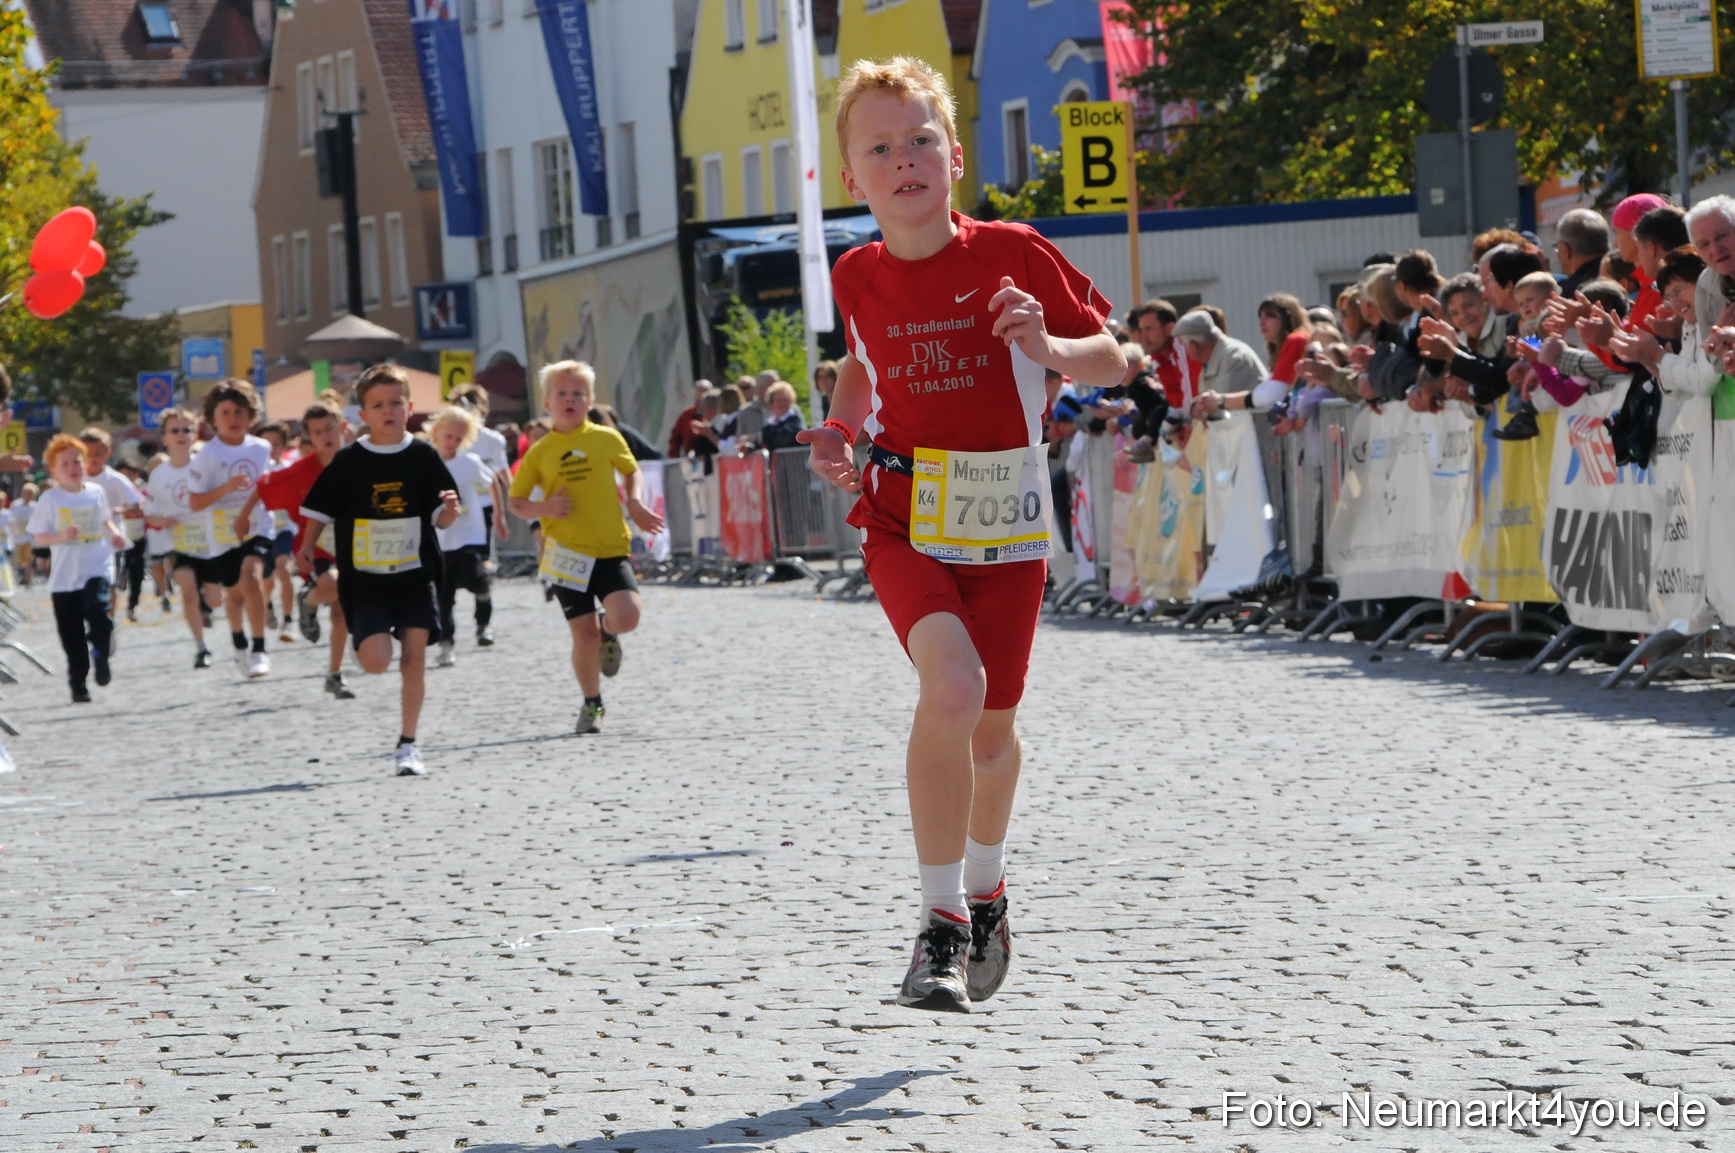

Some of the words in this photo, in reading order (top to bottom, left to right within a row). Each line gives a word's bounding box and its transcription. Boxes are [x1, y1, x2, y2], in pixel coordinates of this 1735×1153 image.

[1651, 2, 1699, 12] Marktplatz
[1507, 26, 1538, 39] Gasse
[559, 1, 595, 119] RUPPERT
[748, 91, 786, 131] HOTEL
[1070, 107, 1124, 127] Block
[1082, 136, 1117, 188] B
[887, 324, 904, 338] 30.
[906, 315, 975, 336] Straßenlauf
[910, 339, 956, 367] DJK
[448, 366, 466, 388] C
[907, 375, 974, 395] 17.04.2010
[954, 459, 1010, 482] Moritz
[918, 489, 936, 506] K4
[954, 490, 1041, 527] 7030
[373, 538, 415, 556] 7274
[999, 540, 1051, 554] PFLEIDERER
[552, 553, 588, 575] 7273
